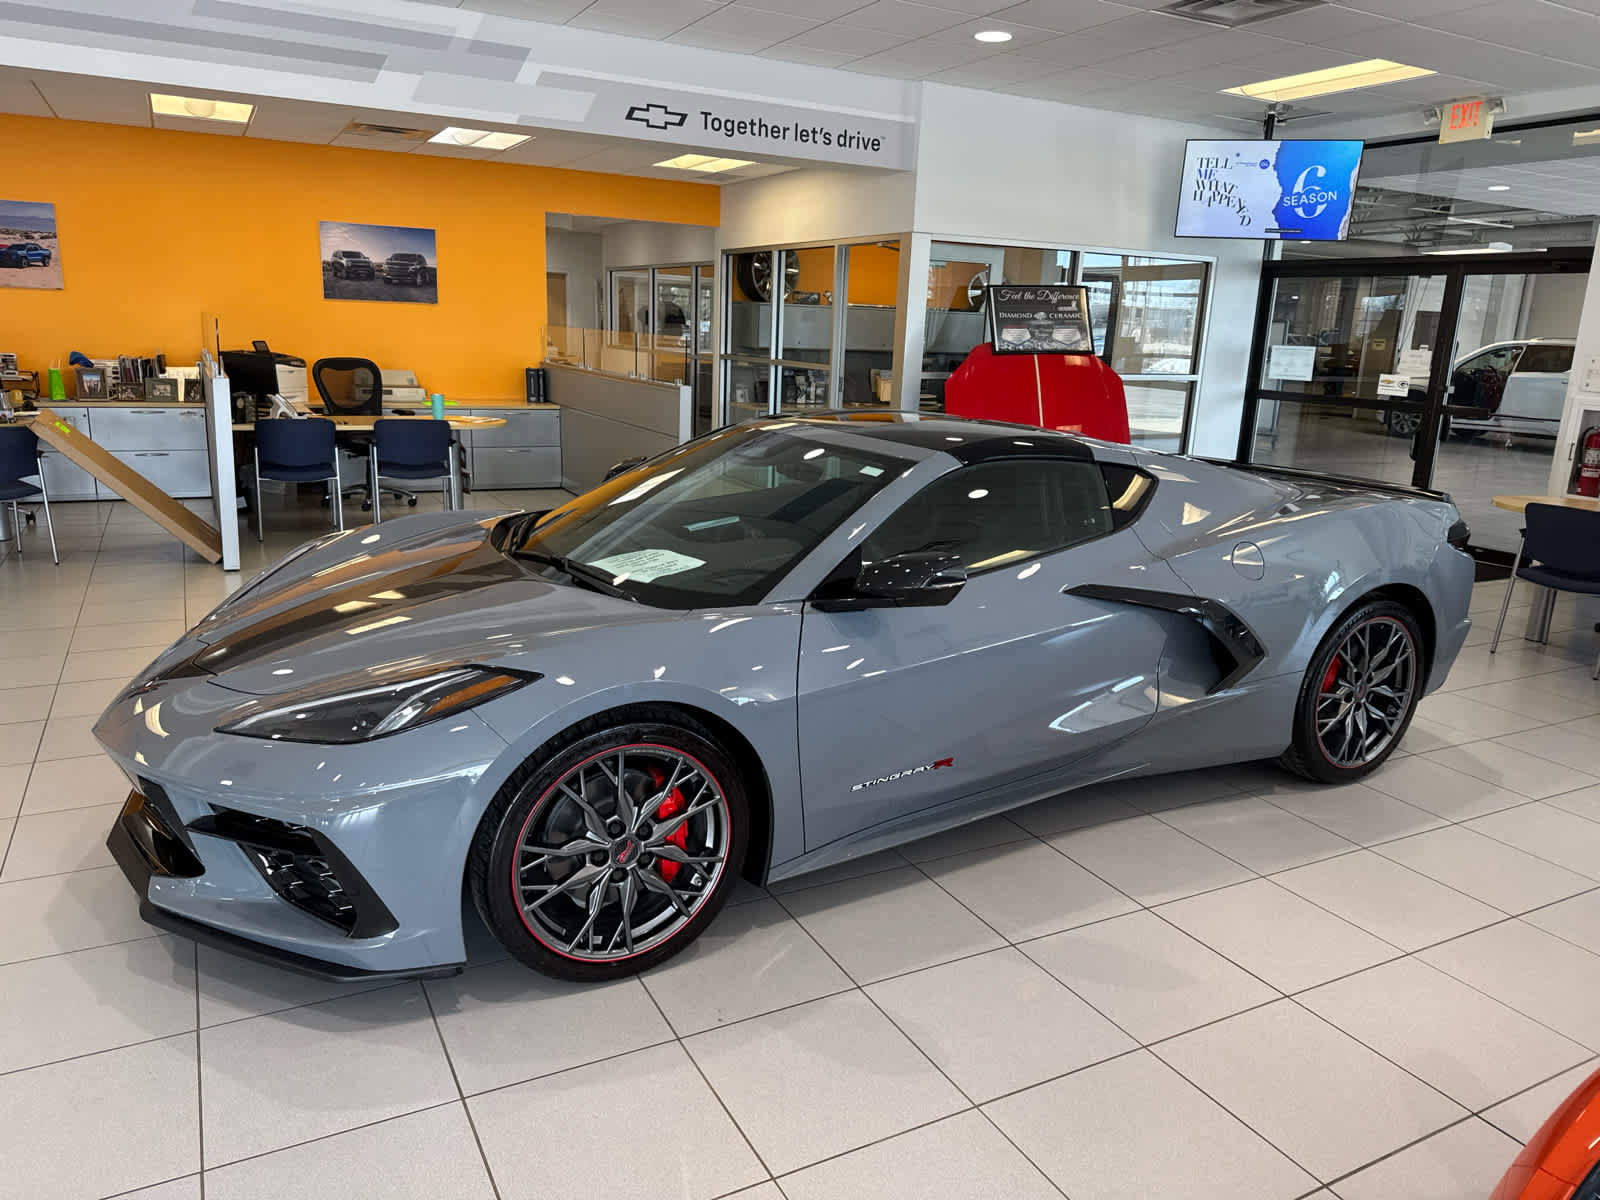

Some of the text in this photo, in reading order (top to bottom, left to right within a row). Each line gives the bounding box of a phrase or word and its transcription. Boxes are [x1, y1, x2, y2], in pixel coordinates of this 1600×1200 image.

[1449, 101, 1482, 130] EXIT
[700, 111, 881, 152] Together let's drive
[1196, 157, 1232, 170] TELL
[1197, 168, 1217, 180] ME
[1196, 180, 1239, 195] WHAT
[1292, 165, 1326, 219] 6
[1283, 191, 1338, 207] SEASON
[998, 289, 1022, 301] Feel
[850, 763, 934, 792] STINGRAY
